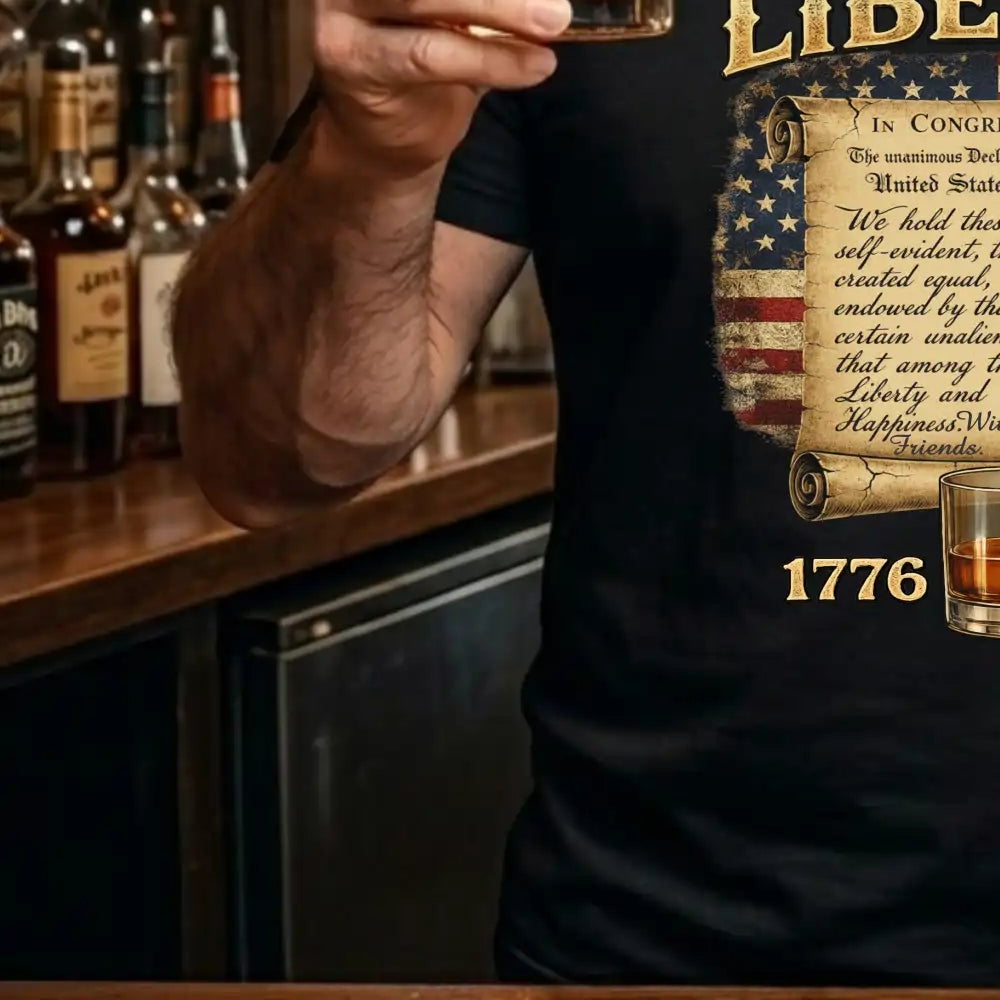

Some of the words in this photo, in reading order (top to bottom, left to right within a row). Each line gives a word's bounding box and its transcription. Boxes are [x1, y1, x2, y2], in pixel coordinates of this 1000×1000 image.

[847, 148, 879, 164] The
[884, 151, 962, 164] unanimous
[865, 173, 939, 194] United
[835, 205, 908, 232] We
[899, 208, 954, 231] hold
[834, 236, 981, 270] self-evident,
[834, 265, 920, 288] created
[924, 265, 991, 299] equal,
[834, 292, 931, 317] endowed
[936, 292, 968, 327] by
[834, 323, 913, 345] certain
[835, 350, 889, 374] that
[896, 359, 975, 384] among
[834, 377, 930, 415] Liberty
[939, 380, 988, 404] and
[889, 434, 983, 457] Friends.
[783, 557, 928, 602] 1776
